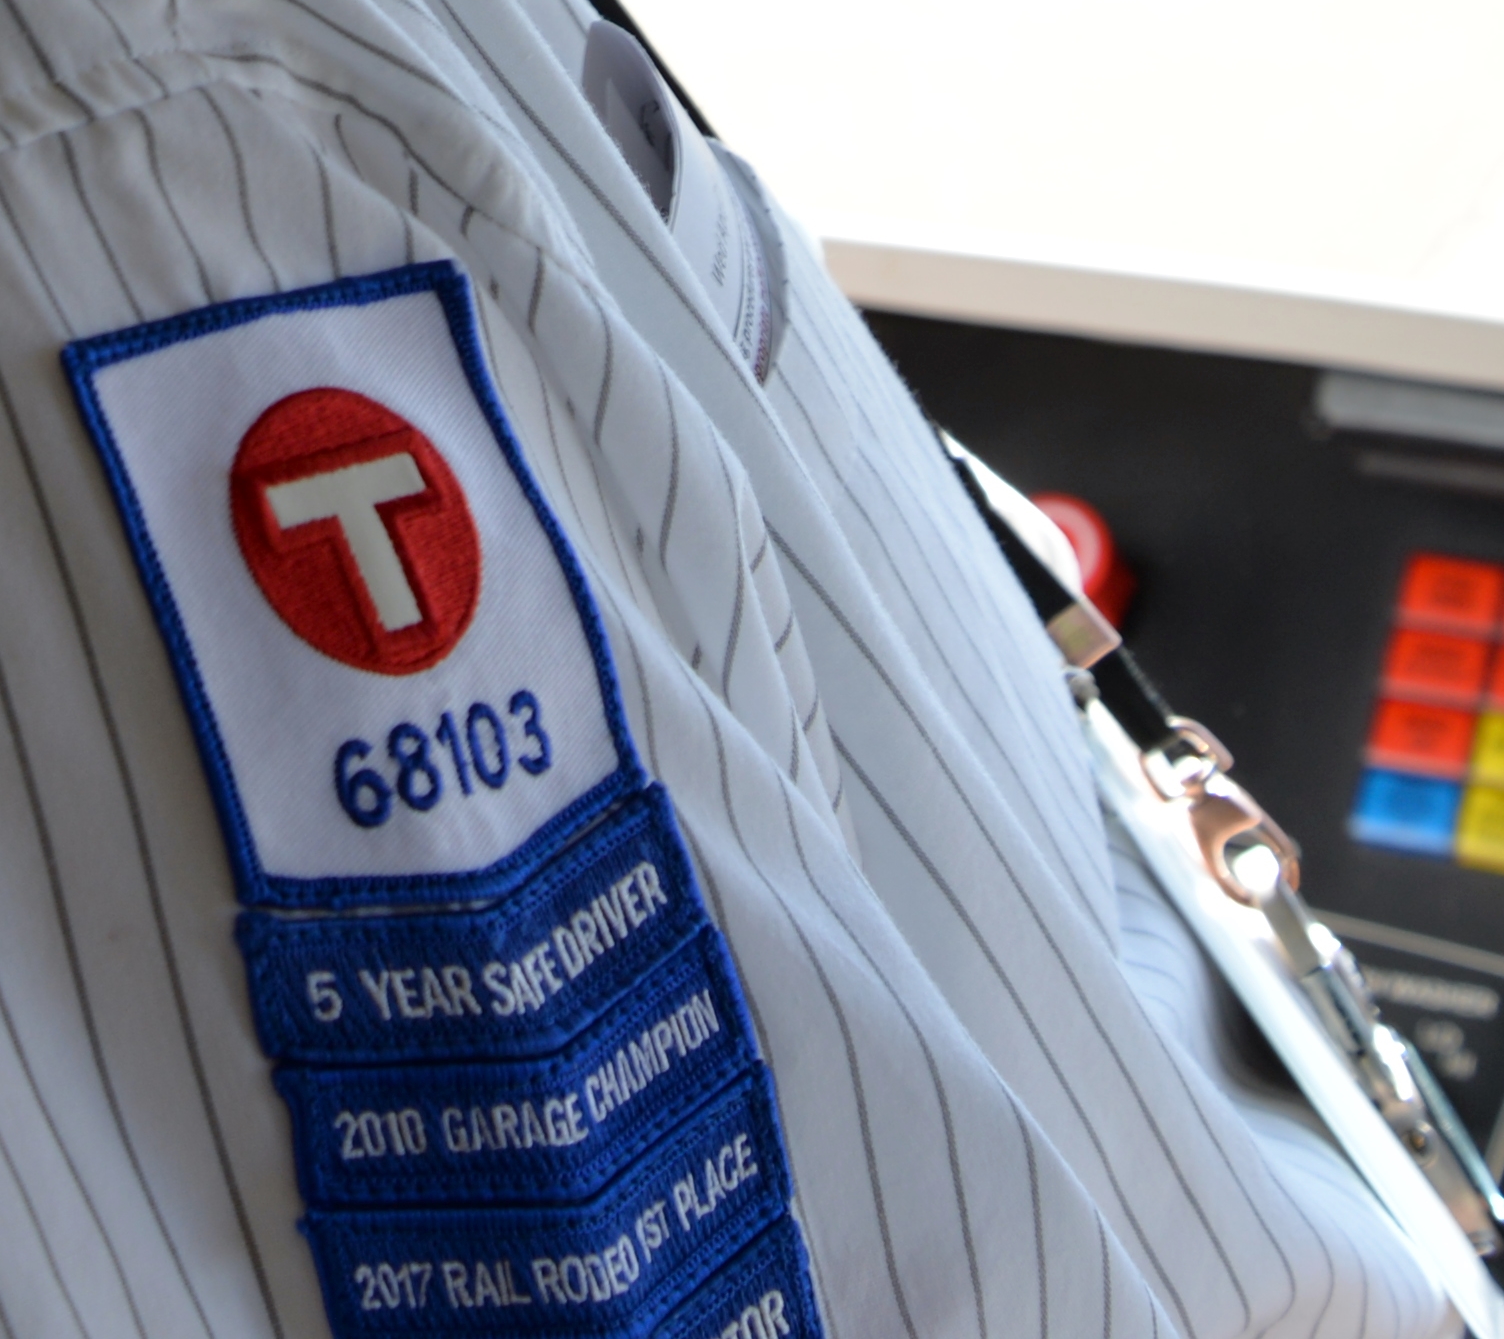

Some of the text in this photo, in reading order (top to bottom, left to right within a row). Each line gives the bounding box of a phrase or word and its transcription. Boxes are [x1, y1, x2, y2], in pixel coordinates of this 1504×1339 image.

[264, 452, 427, 633] T
[334, 689, 552, 830] 68103
[305, 860, 668, 1022] 5 YEAR SAFE DRIVER
[334, 988, 721, 1160] 2010 GARAGE CHAMPION
[353, 1261, 433, 1311] 2017
[441, 1260, 533, 1309] RAIL
[531, 1233, 640, 1304] RODEO
[672, 1132, 759, 1232] PLACE
